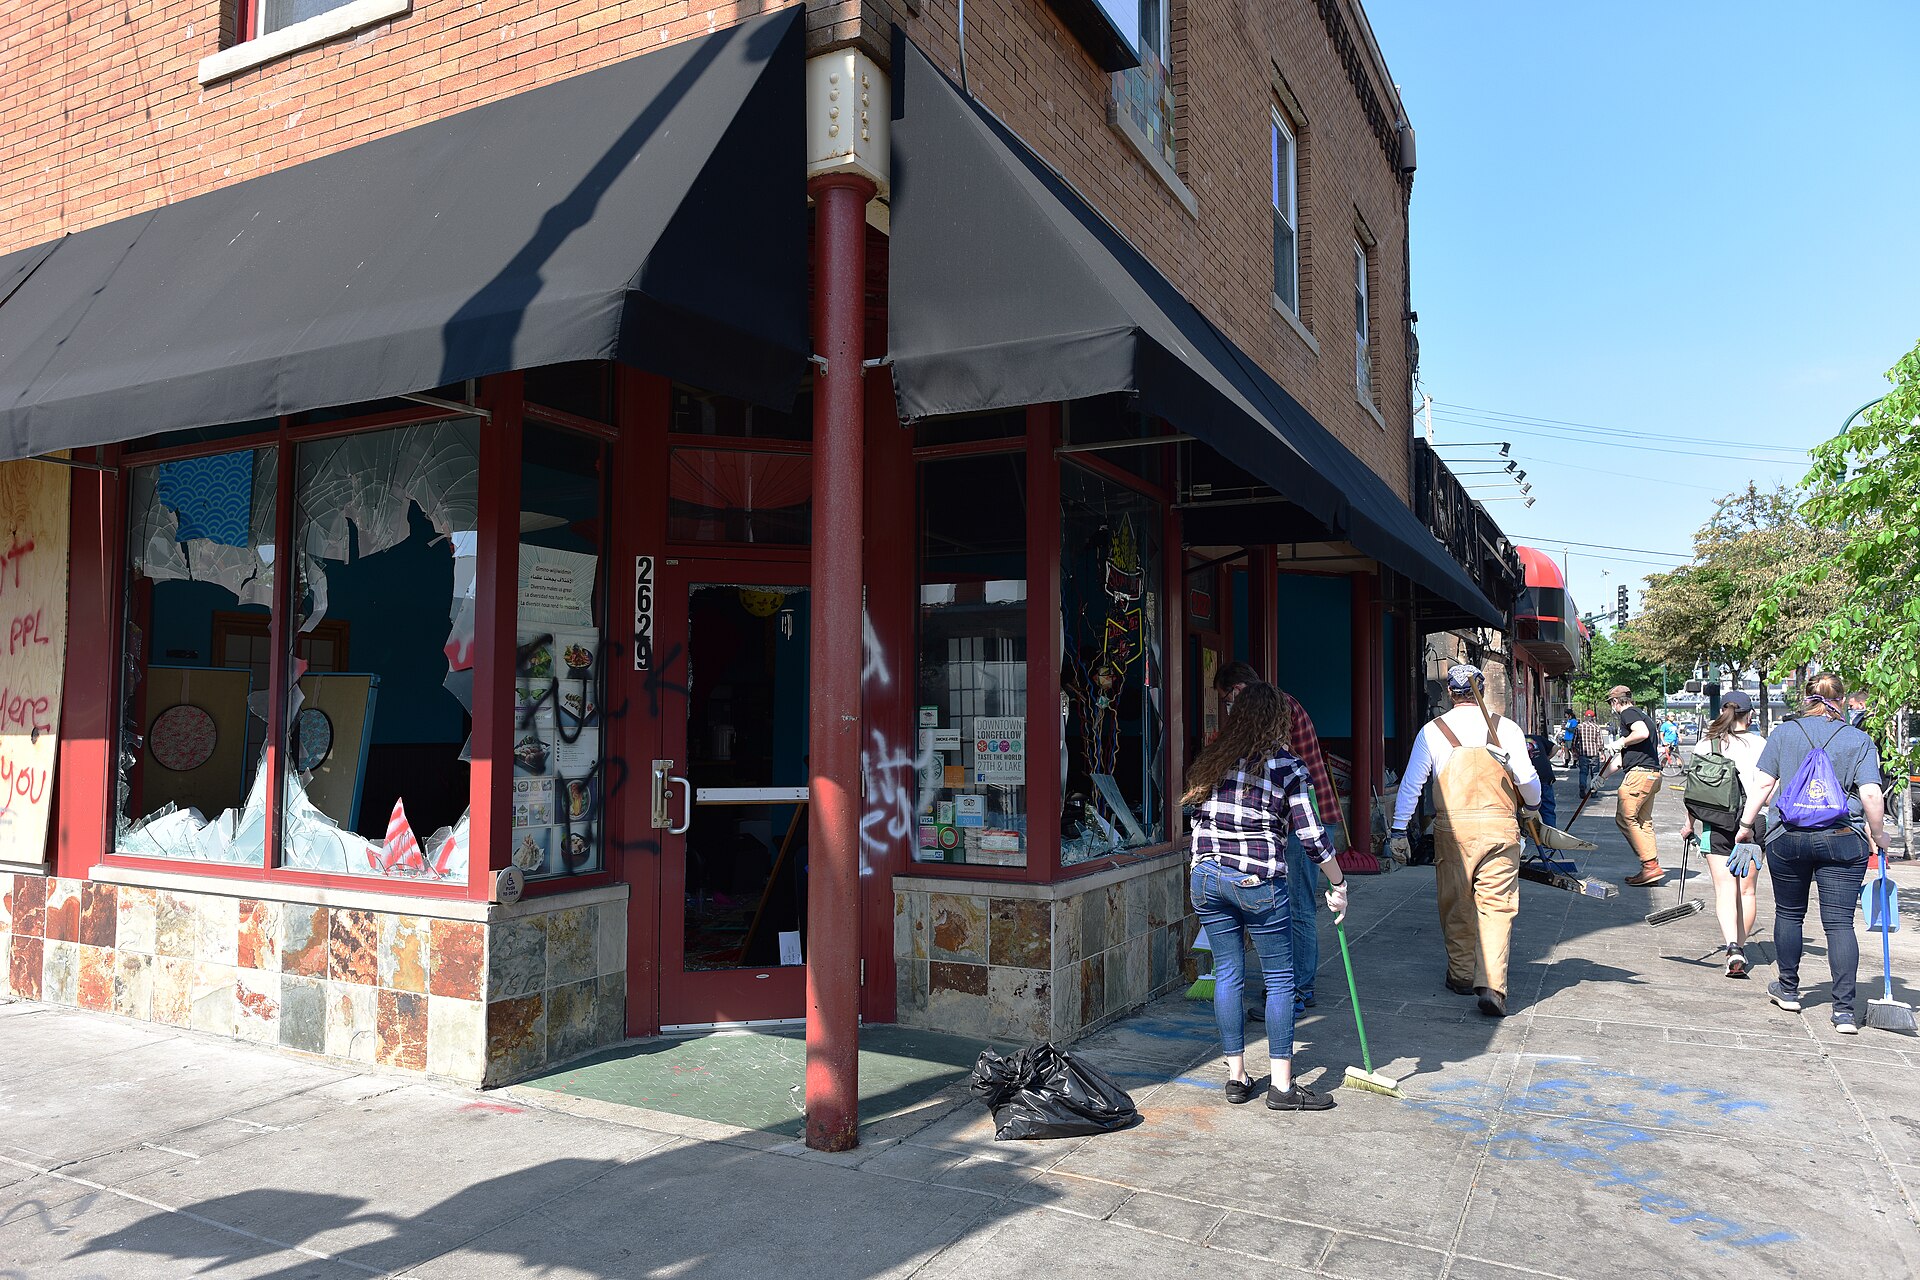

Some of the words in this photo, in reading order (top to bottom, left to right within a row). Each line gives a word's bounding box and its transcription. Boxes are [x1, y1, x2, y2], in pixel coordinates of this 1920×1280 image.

[636, 557, 652, 669] 2629
[977, 719, 1022, 730] DOWNTOWN
[977, 730, 1022, 740] LONGFELLOW
[978, 761, 995, 771] 27TH
[997, 761, 1003, 771] &
[1005, 761, 1022, 771] LAKE
